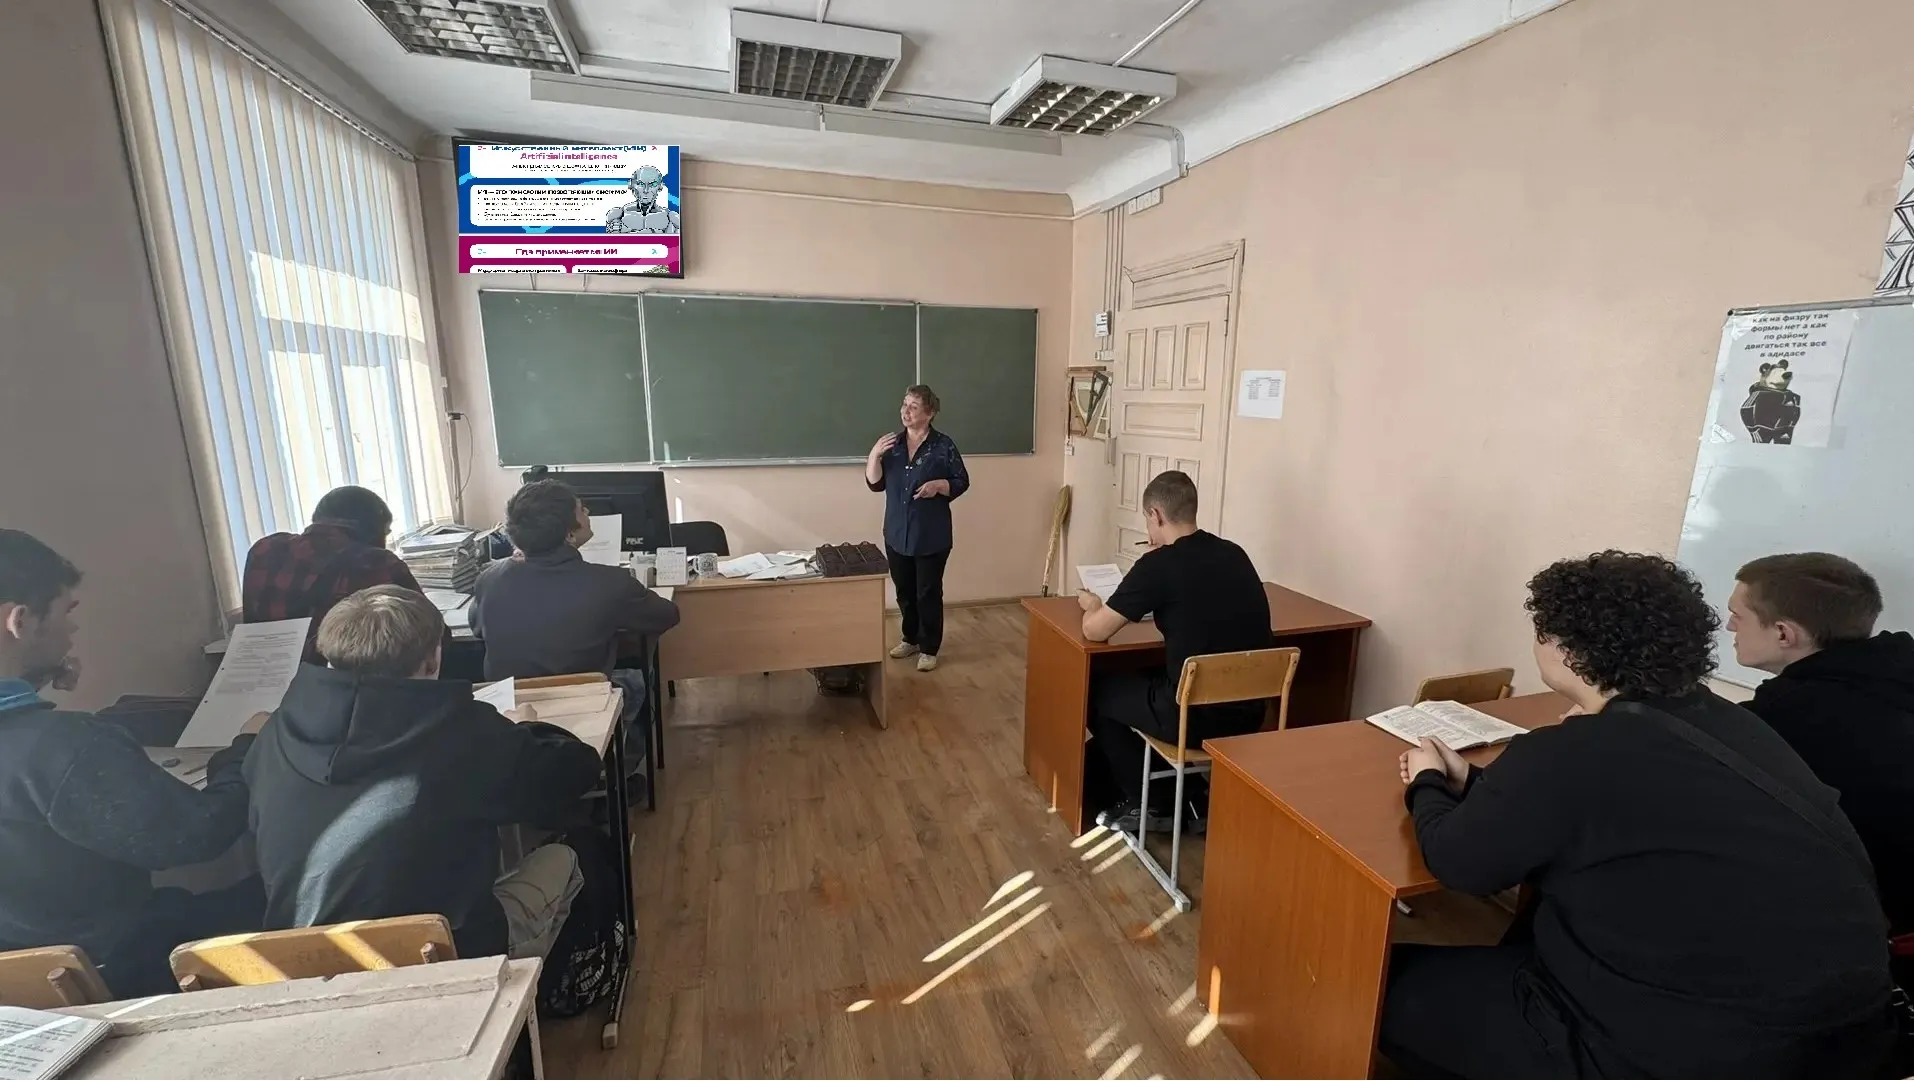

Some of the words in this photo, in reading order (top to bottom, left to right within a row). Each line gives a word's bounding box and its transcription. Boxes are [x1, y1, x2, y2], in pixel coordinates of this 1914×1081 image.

[1782, 314, 1811, 323] физру
[1751, 325, 1783, 333] формы
[1776, 332, 1809, 341] району
[1767, 350, 1806, 358] адидасе
